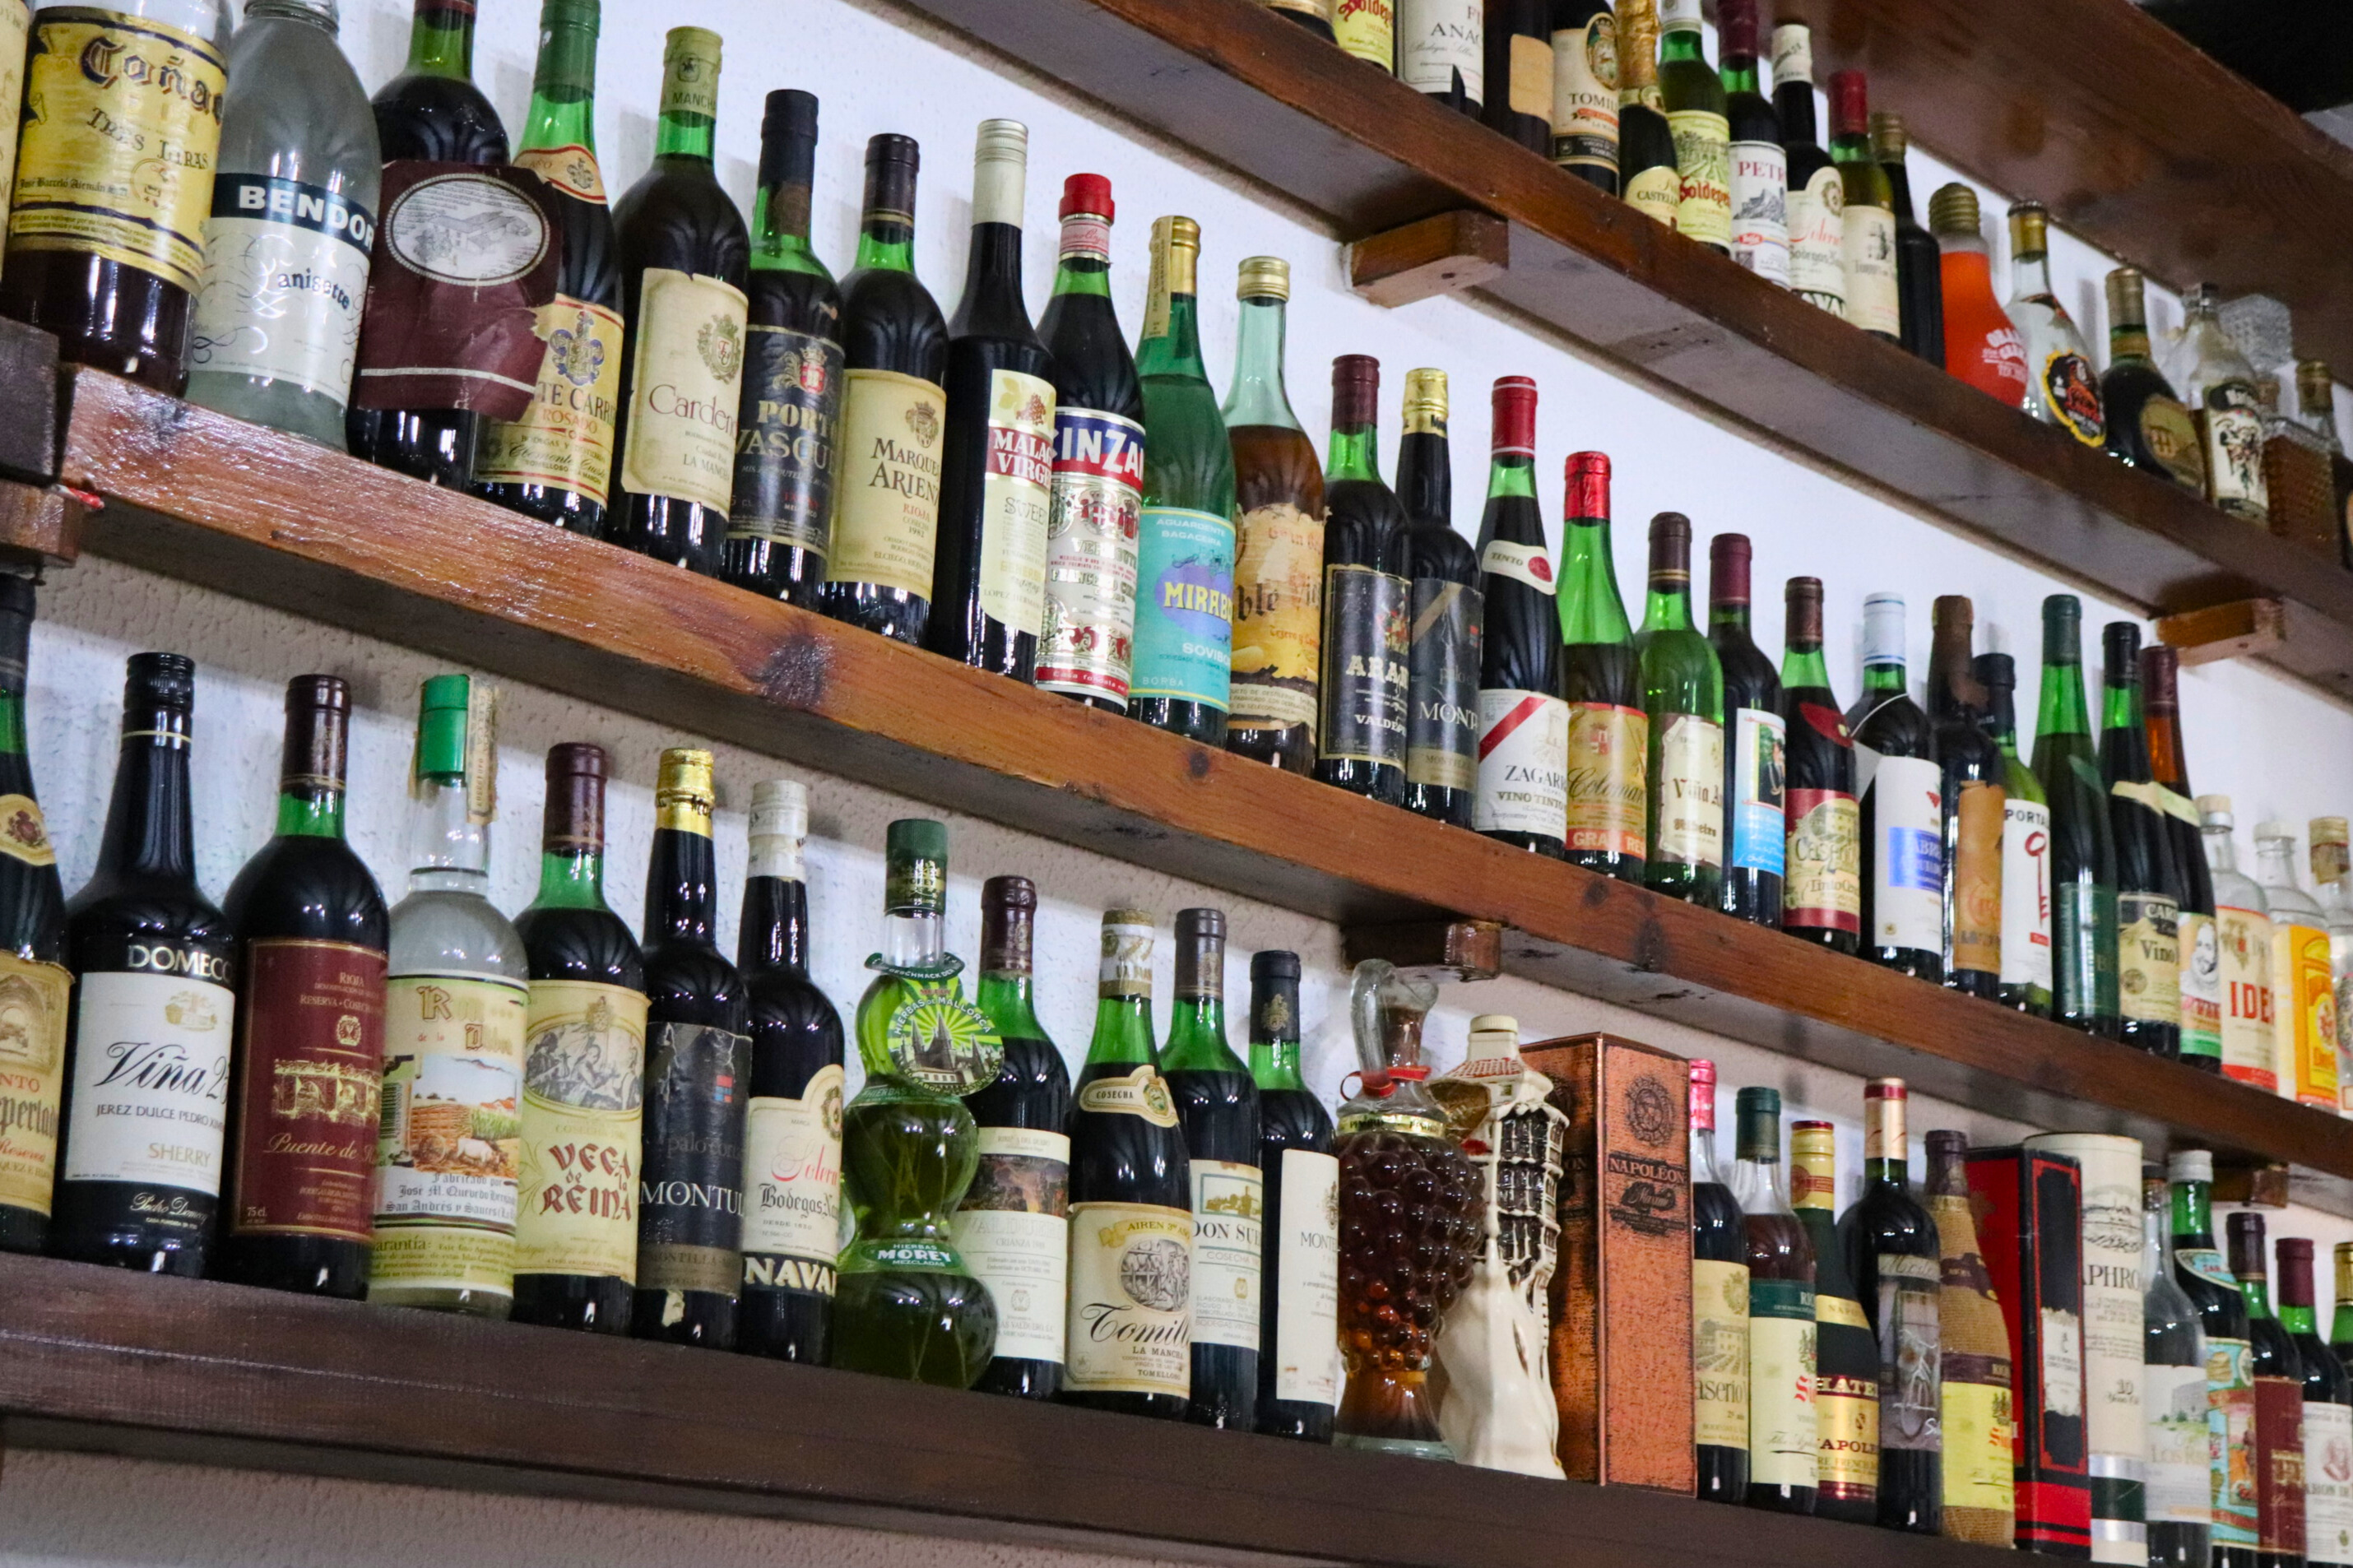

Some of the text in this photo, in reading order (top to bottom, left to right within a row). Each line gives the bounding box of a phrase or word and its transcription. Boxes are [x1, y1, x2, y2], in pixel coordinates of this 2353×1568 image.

[278, 267, 351, 311] anisette
[543, 409, 598, 434] ROSADO
[1052, 427, 1144, 481] INZA
[903, 503, 931, 522] RIOJA
[1156, 518, 1226, 538] AGUARDENTE
[1161, 530, 1222, 547] BAGACEIRA
[1490, 550, 1524, 567] TINTO
[1142, 676, 1185, 687] BORBA
[1497, 791, 1564, 811] VINO TINTO
[339, 971, 365, 987] RIOJA
[299, 993, 338, 1007] RESERVA
[893, 998, 926, 1036] HIERBAS
[938, 996, 991, 1034] MALLORCA
[93, 1041, 208, 1095] Viña
[914, 1077, 941, 1093] SABOR
[1095, 1090, 1135, 1100] COSECHA
[96, 1103, 209, 1127] JEREZ DULCE PEDRO
[262, 1132, 358, 1161] Puente de
[667, 1131, 706, 1159] palo
[147, 1142, 211, 1168] SHERRY
[548, 1142, 632, 1180] VEGA
[565, 1167, 628, 1192] de la
[398, 1183, 423, 1199] José
[130, 1191, 169, 1215] Pedro
[385, 1201, 408, 1212] San
[411, 1199, 452, 1213] Andrés
[539, 1183, 632, 1222] REINA
[759, 1183, 823, 1219] Bodegas
[1126, 1220, 1165, 1232] AIREN
[995, 1237, 1031, 1249] CRIANZA
[877, 1249, 952, 1263] MOREY
[892, 1260, 946, 1268] MEZCLADAS
[1132, 1346, 1147, 1355] LA
[1136, 1368, 1181, 1381] TOMELLOSO
